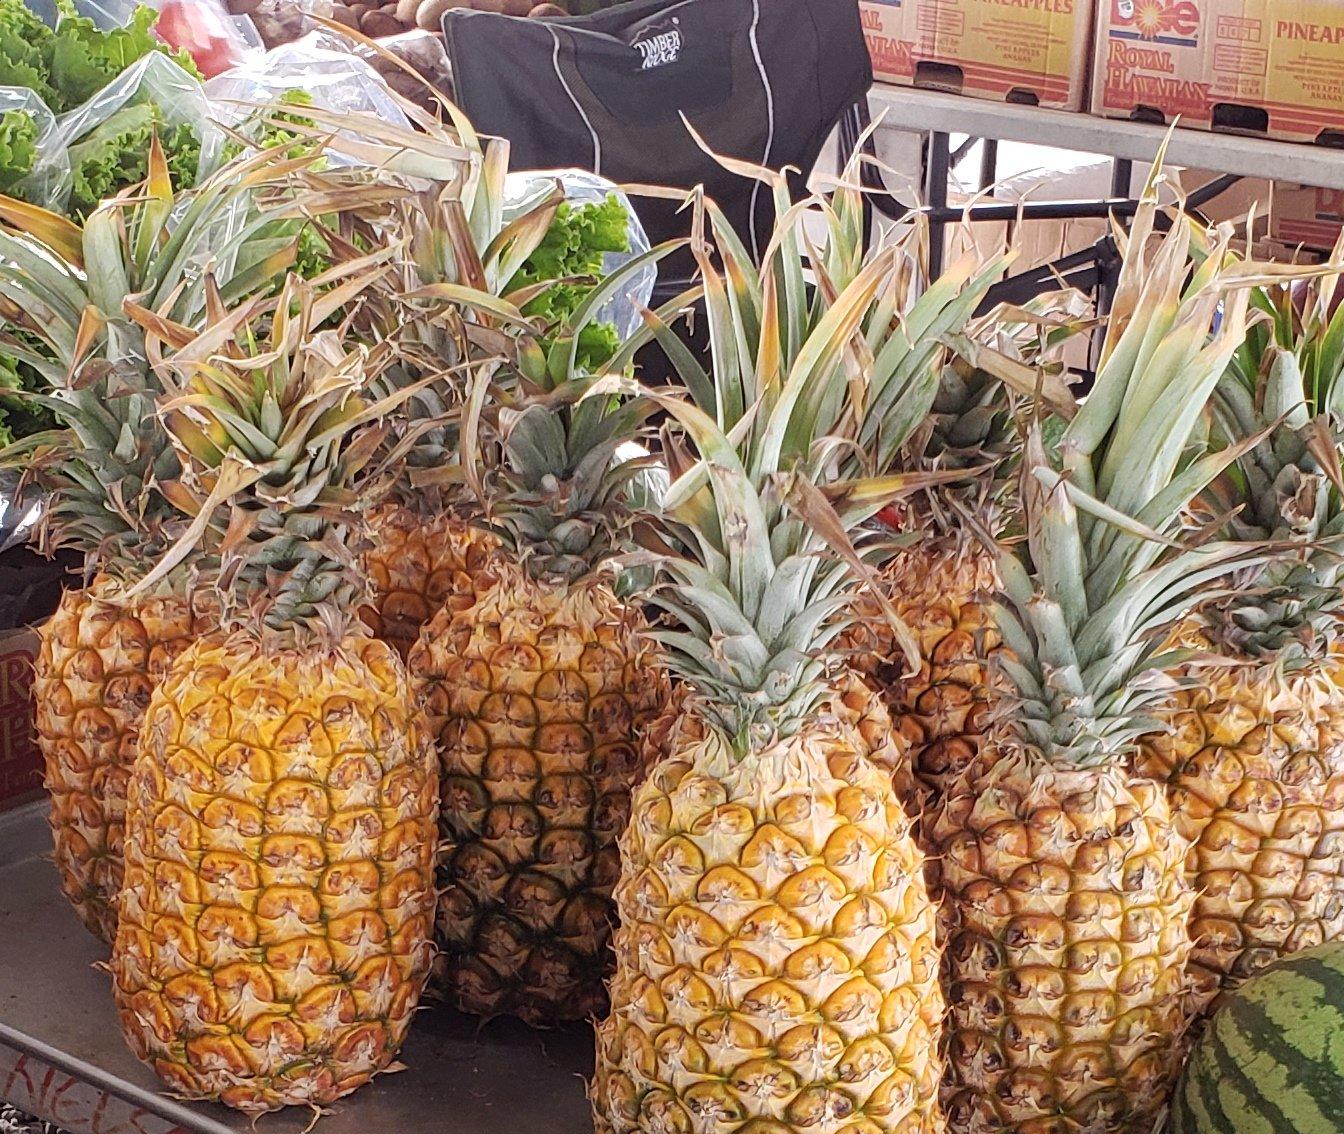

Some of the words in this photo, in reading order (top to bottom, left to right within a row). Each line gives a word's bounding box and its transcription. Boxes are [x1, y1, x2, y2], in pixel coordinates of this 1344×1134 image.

[633, 30, 681, 58] TIMBER
[1109, 40, 1174, 73] ROYAL
[1107, 66, 1212, 100] HAWAIIAN
